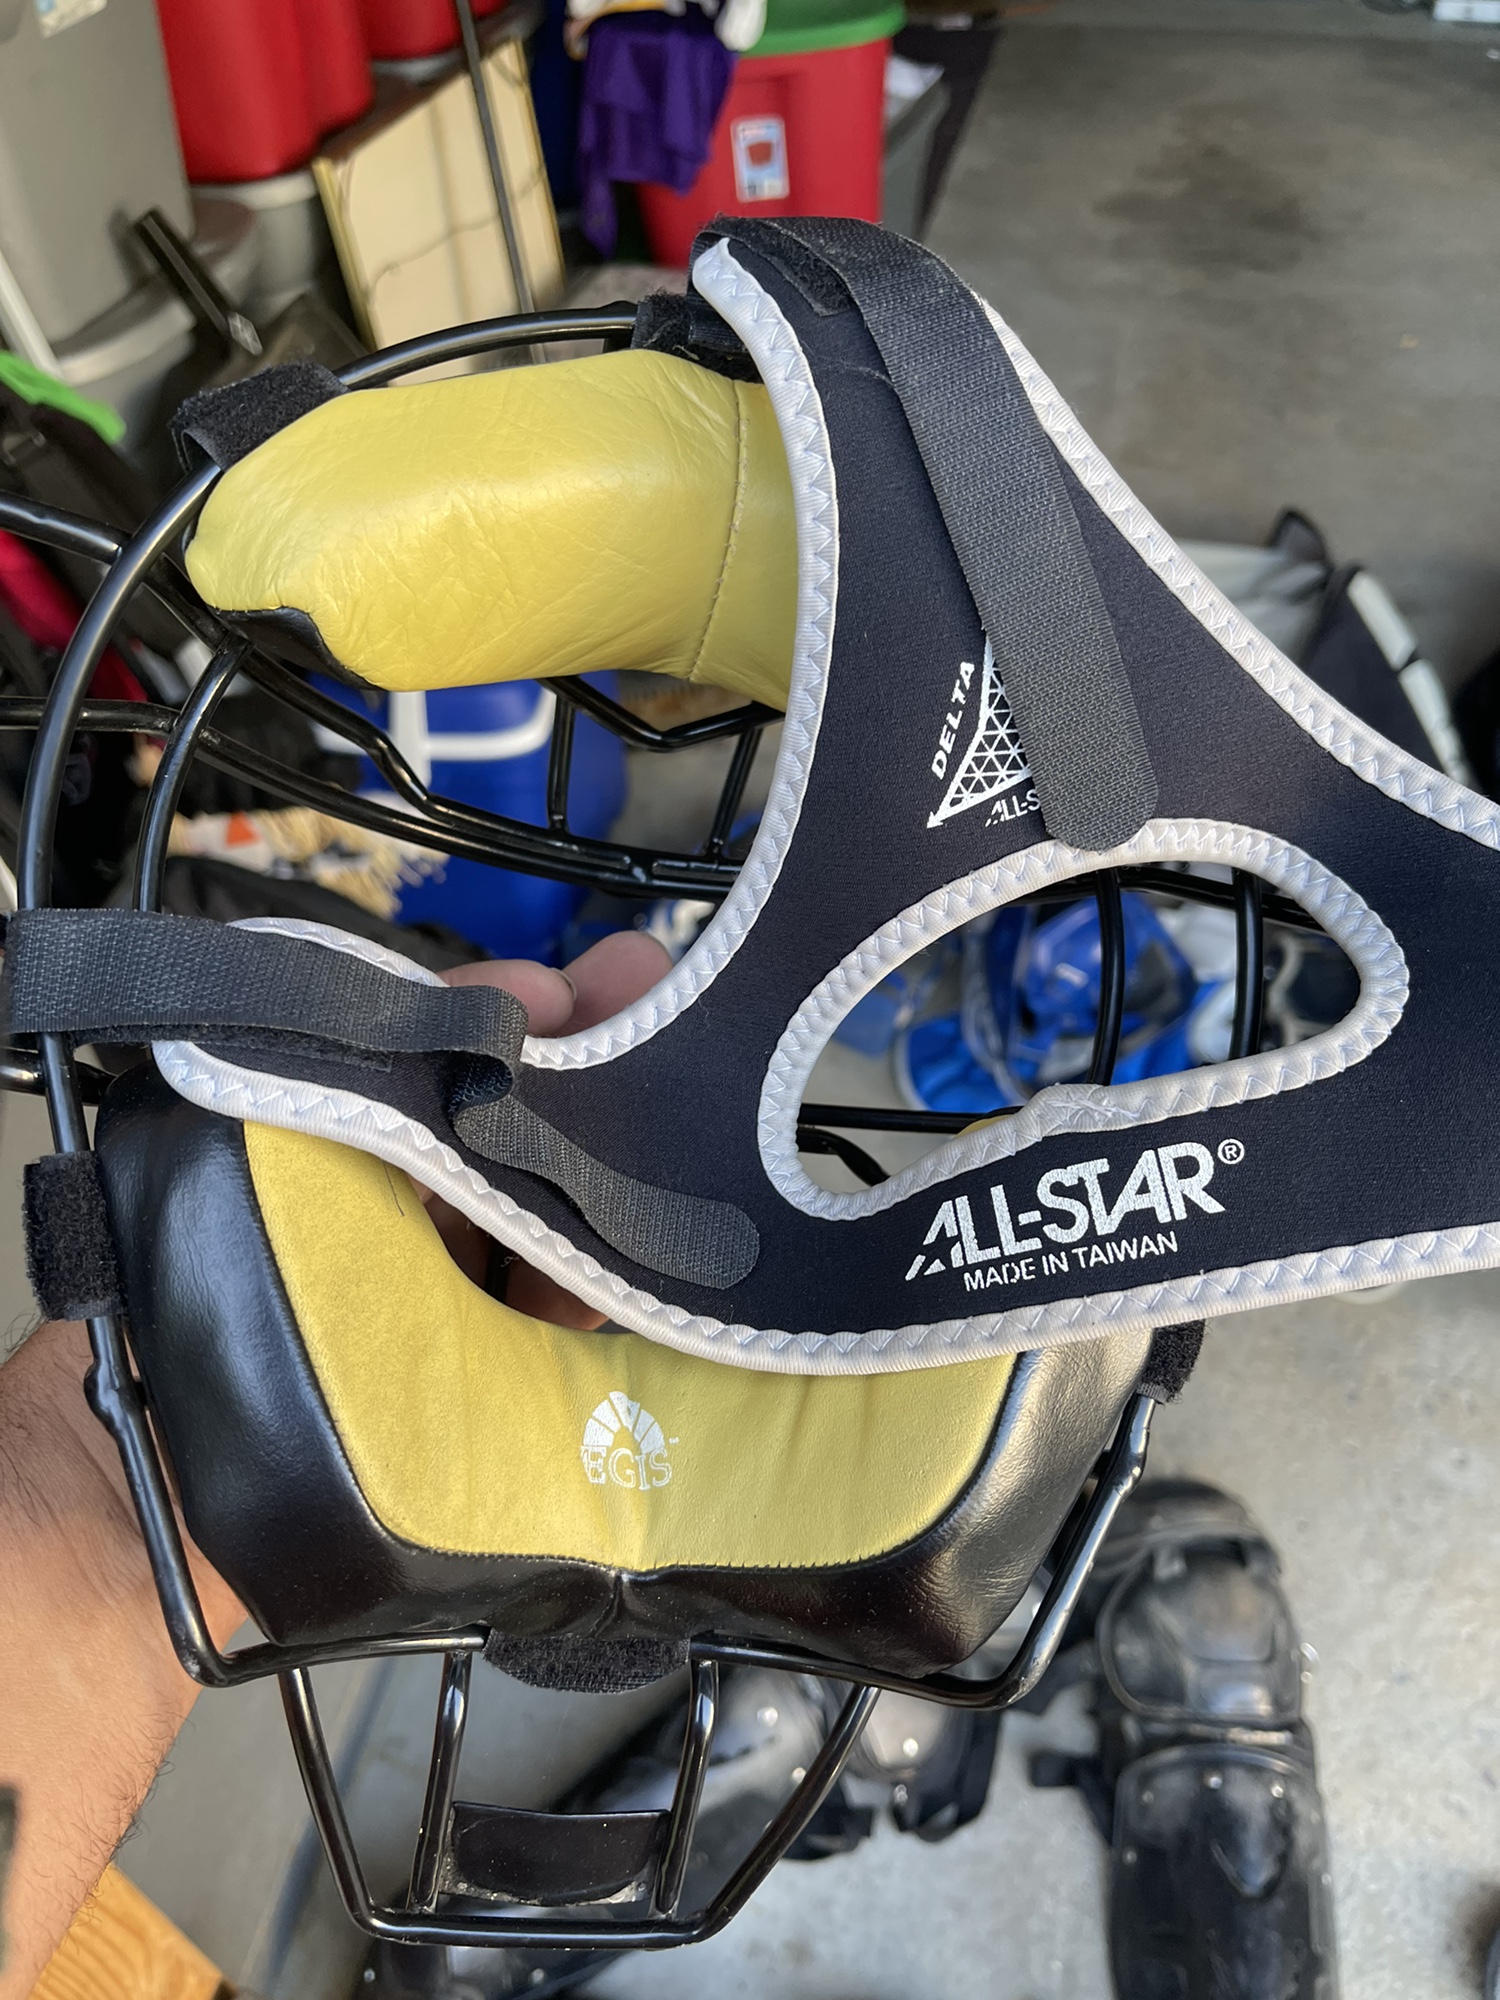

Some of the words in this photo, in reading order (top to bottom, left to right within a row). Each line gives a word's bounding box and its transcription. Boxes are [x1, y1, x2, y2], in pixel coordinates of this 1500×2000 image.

[931, 661, 975, 780] DELTA
[985, 788, 1041, 827] ALL-S
[963, 1258, 1036, 1292] MADE
[1042, 1252, 1070, 1276] IN
[1071, 1230, 1179, 1272] TAIWAN
